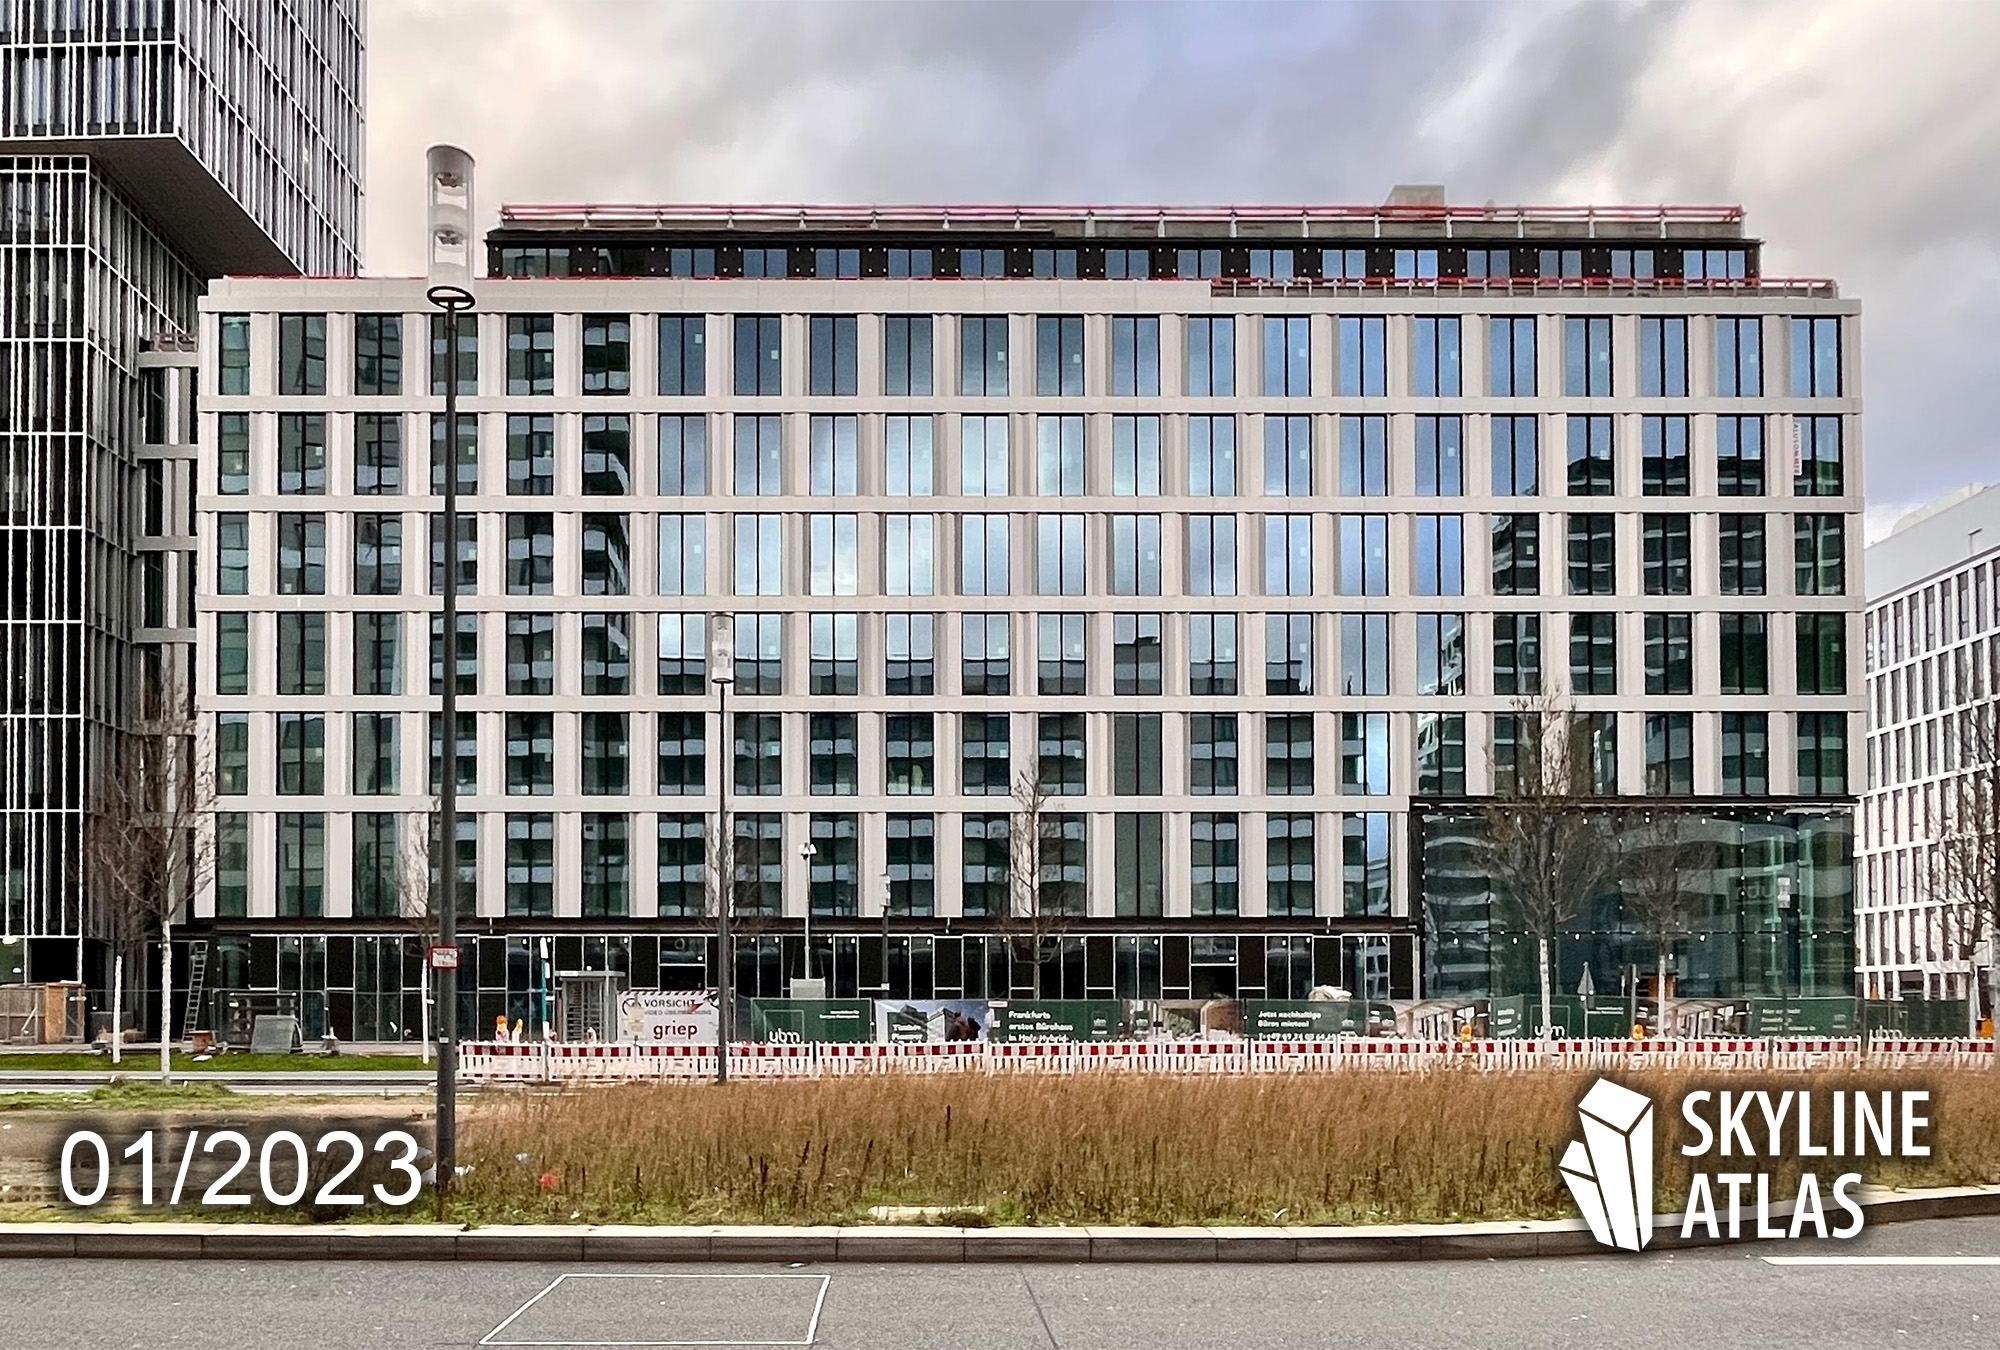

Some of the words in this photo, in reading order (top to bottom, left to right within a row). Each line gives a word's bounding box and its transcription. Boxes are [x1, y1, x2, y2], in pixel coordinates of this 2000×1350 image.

[644, 999, 696, 1008] VORSICHT
[1008, 1010, 1051, 1019] Frankfurts
[653, 1020, 698, 1040] griep
[1008, 1023, 1034, 1031] erstes
[1534, 1025, 1566, 1037] um
[769, 1027, 801, 1043] ubm
